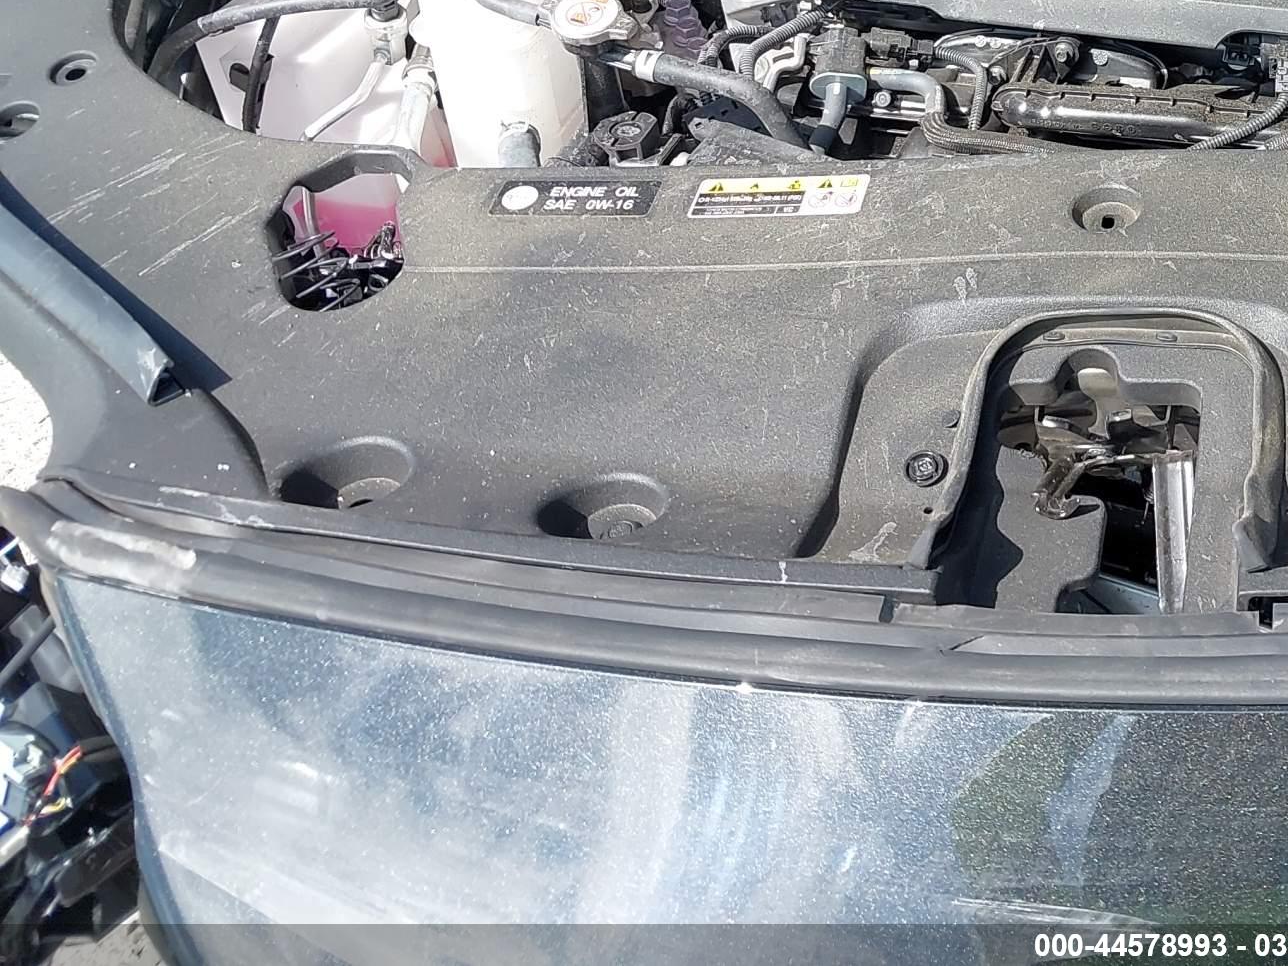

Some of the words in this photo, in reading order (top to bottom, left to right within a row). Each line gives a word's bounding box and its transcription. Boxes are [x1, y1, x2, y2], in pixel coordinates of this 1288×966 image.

[549, 186, 608, 197] ENGINE
[614, 186, 639, 197] OIL
[543, 199, 577, 210] SAE
[585, 199, 634, 210] 0W-16
